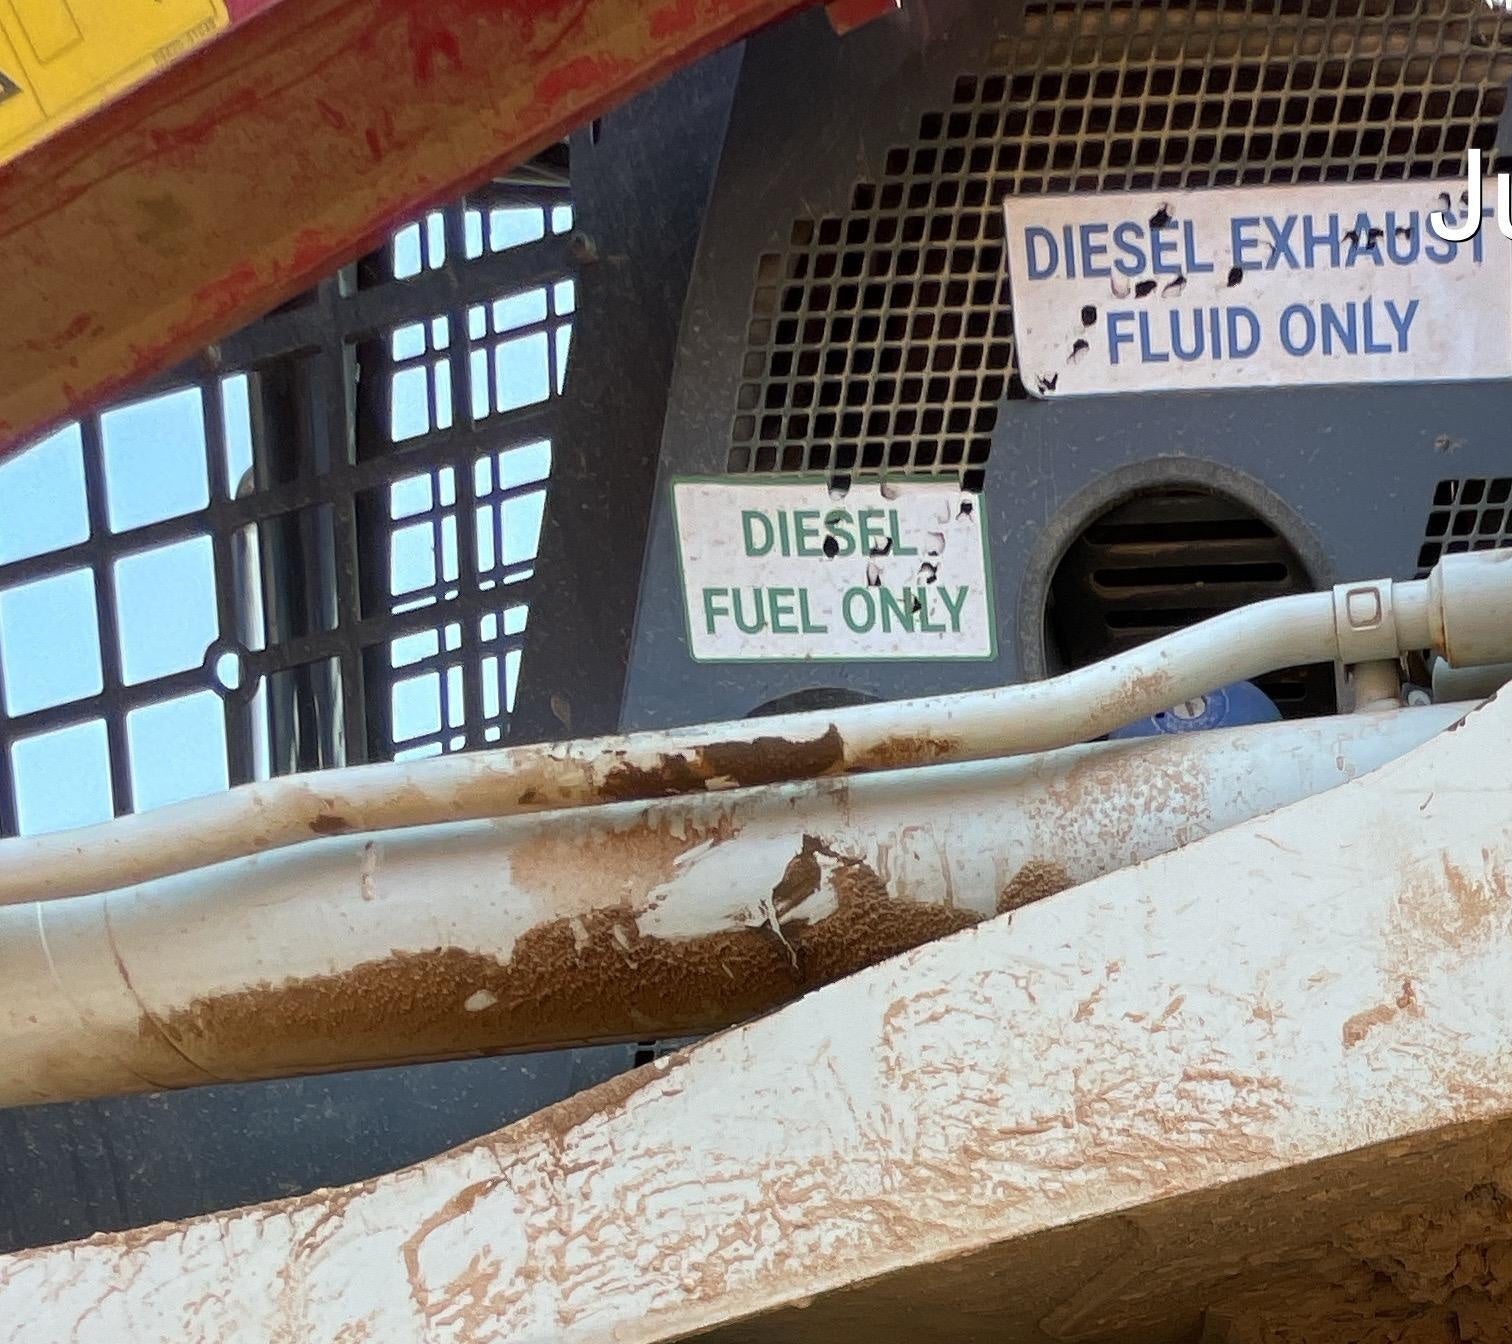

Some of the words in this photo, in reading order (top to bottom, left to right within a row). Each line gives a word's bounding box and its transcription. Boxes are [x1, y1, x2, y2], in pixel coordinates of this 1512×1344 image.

[1024, 213, 1215, 281] DIESEL
[1229, 207, 1495, 272] EXHAUST
[1106, 305, 1261, 365] FLUID
[1279, 299, 1420, 356] ONLY
[741, 508, 918, 558] DIESEL
[702, 586, 828, 635] FUEL
[842, 585, 970, 633] ONLY
